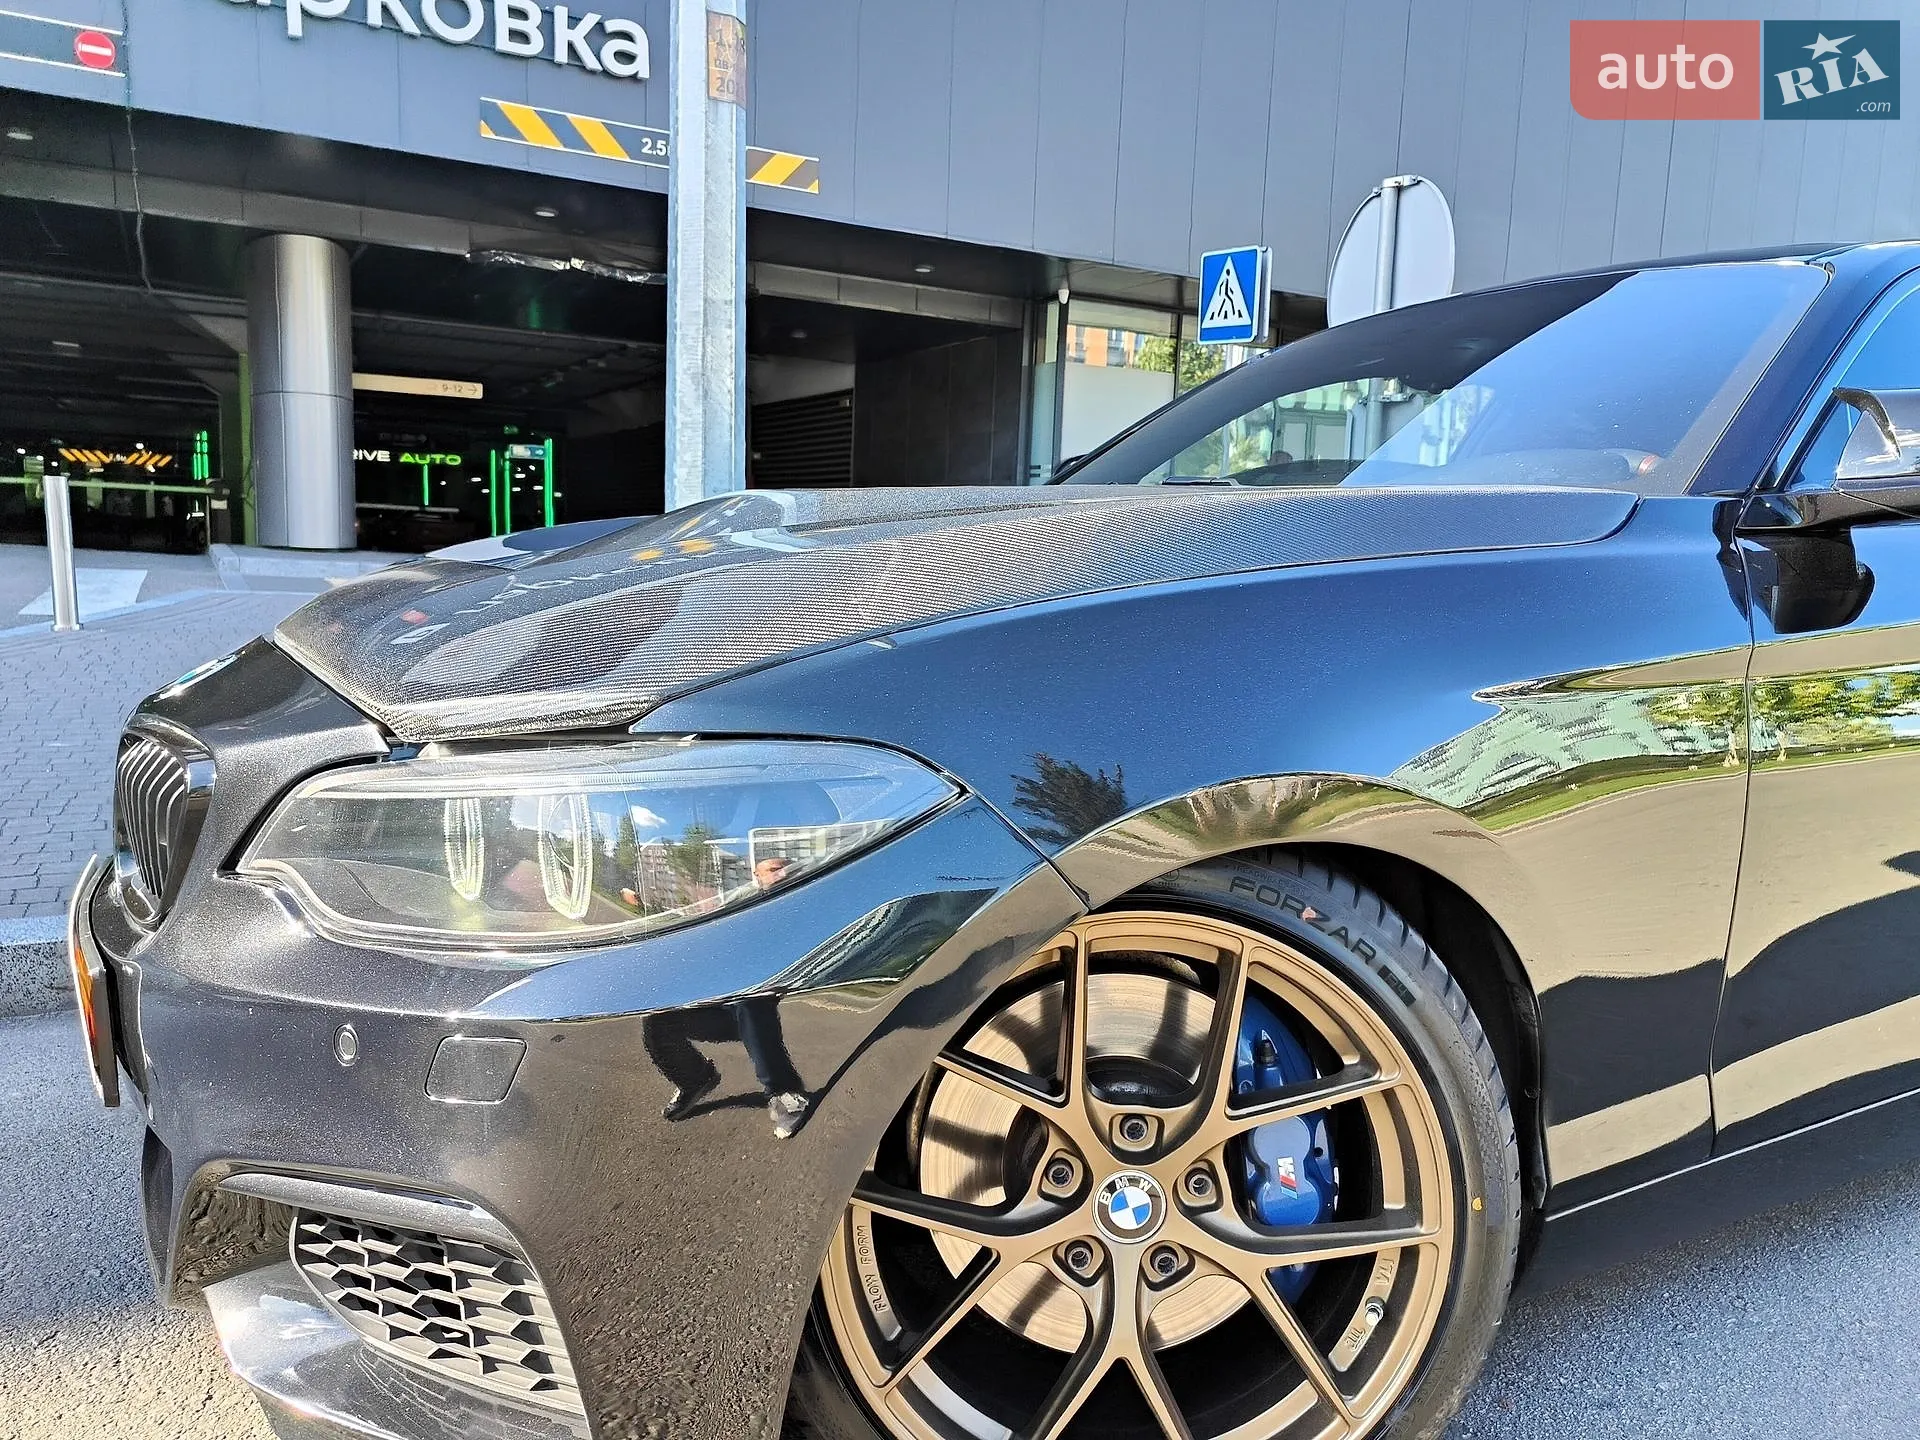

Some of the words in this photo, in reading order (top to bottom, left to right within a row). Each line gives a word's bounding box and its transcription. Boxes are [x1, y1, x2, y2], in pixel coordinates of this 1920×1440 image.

[641, 137, 669, 157] 2.5
[400, 452, 462, 465] AUTO
[1098, 1176, 1153, 1206] BMW
[856, 1225, 872, 1265] FORM
[864, 1273, 888, 1313] FLOW
